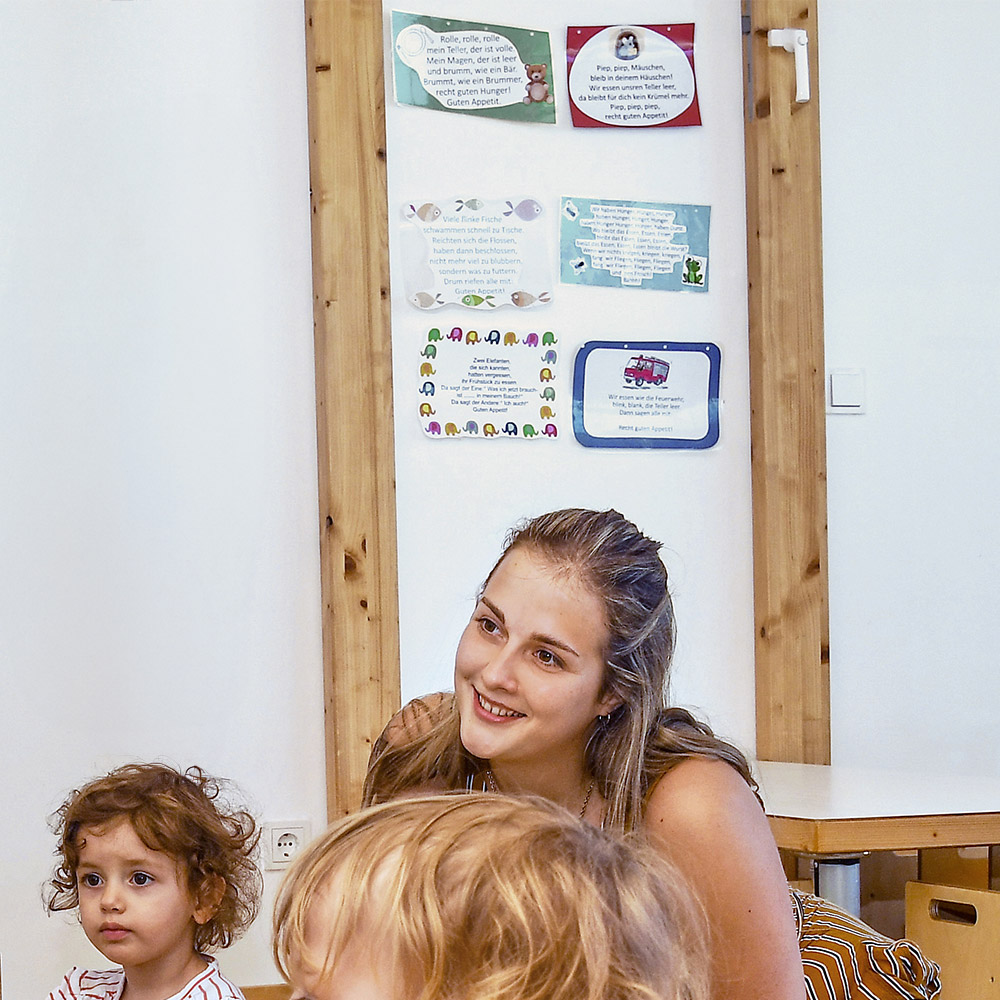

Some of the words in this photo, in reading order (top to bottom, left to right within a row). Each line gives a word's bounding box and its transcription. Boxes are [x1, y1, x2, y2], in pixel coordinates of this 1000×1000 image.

[463, 35, 481, 43] rolle,
[447, 46, 468, 54] Teller,
[448, 57, 475, 65] Magen,
[458, 89, 478, 97] guten
[481, 87, 511, 95] Hunger!
